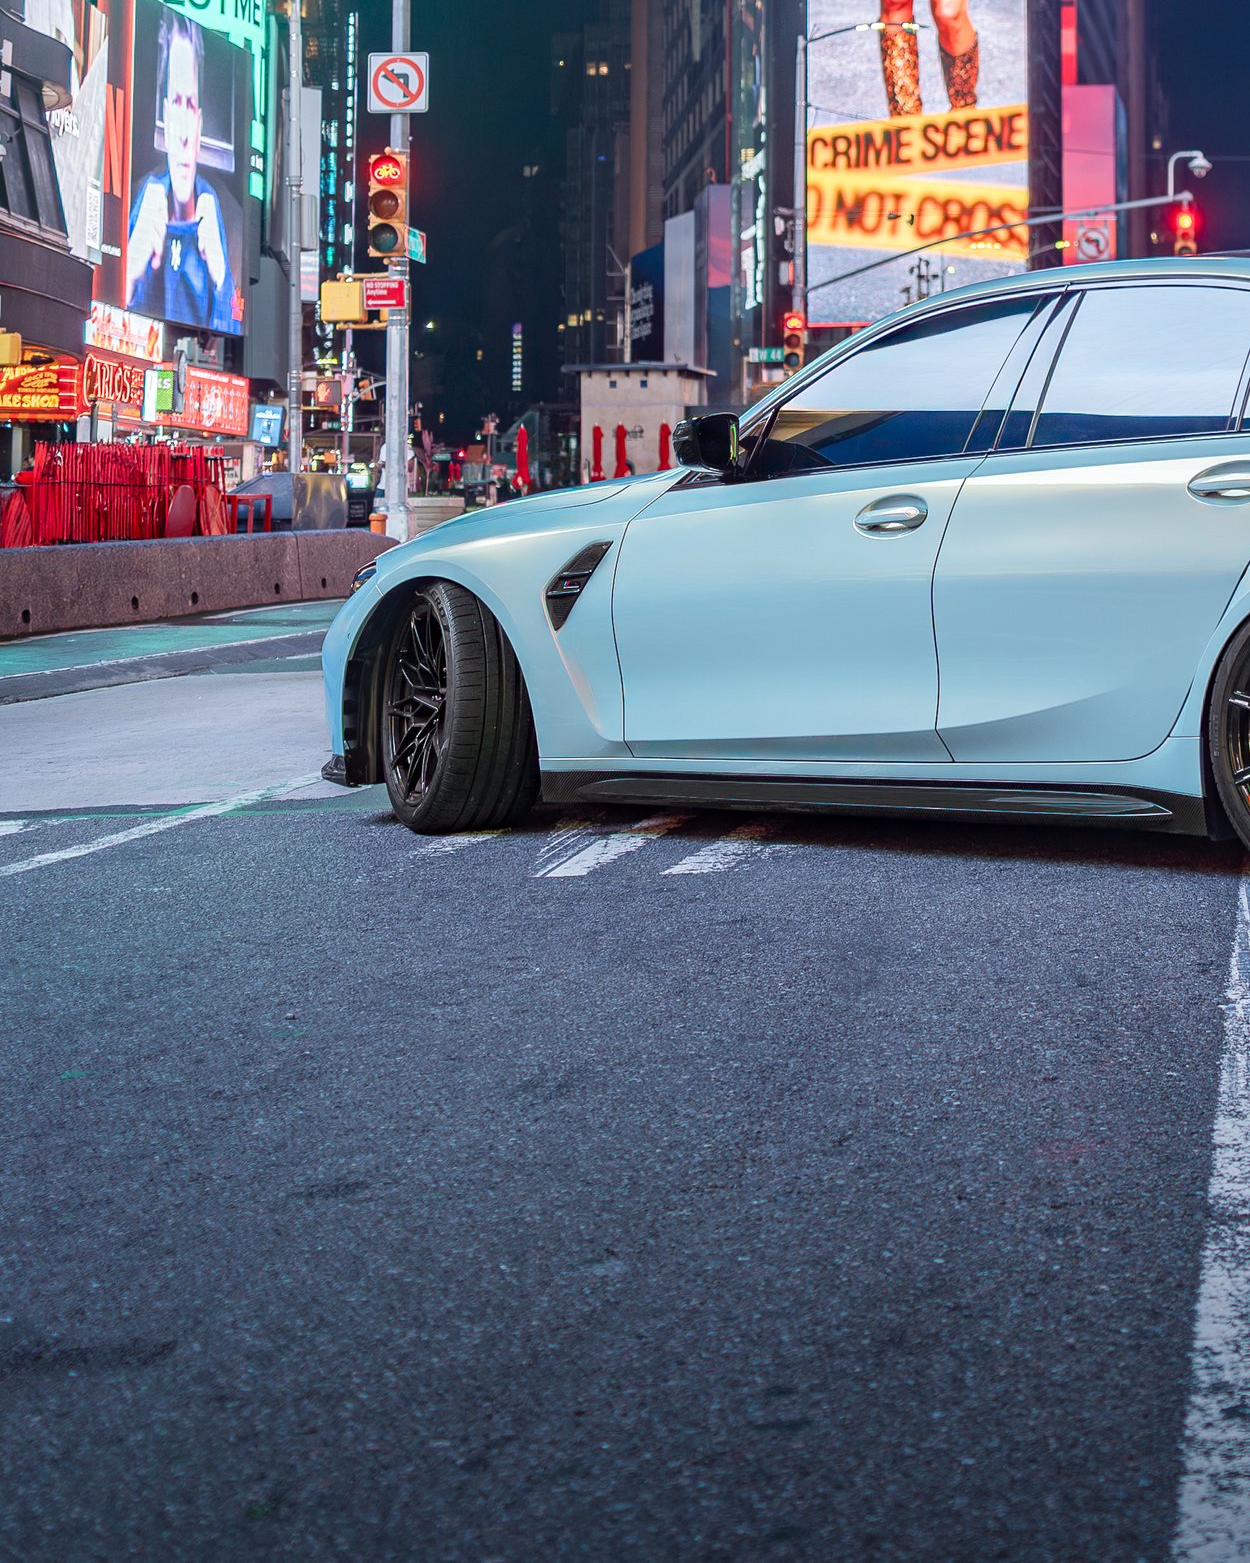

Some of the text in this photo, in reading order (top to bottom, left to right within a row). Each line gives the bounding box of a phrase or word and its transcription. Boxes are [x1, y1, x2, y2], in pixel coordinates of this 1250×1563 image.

[811, 112, 1024, 169] CRIME SCENE
[832, 189, 908, 236] NOT
